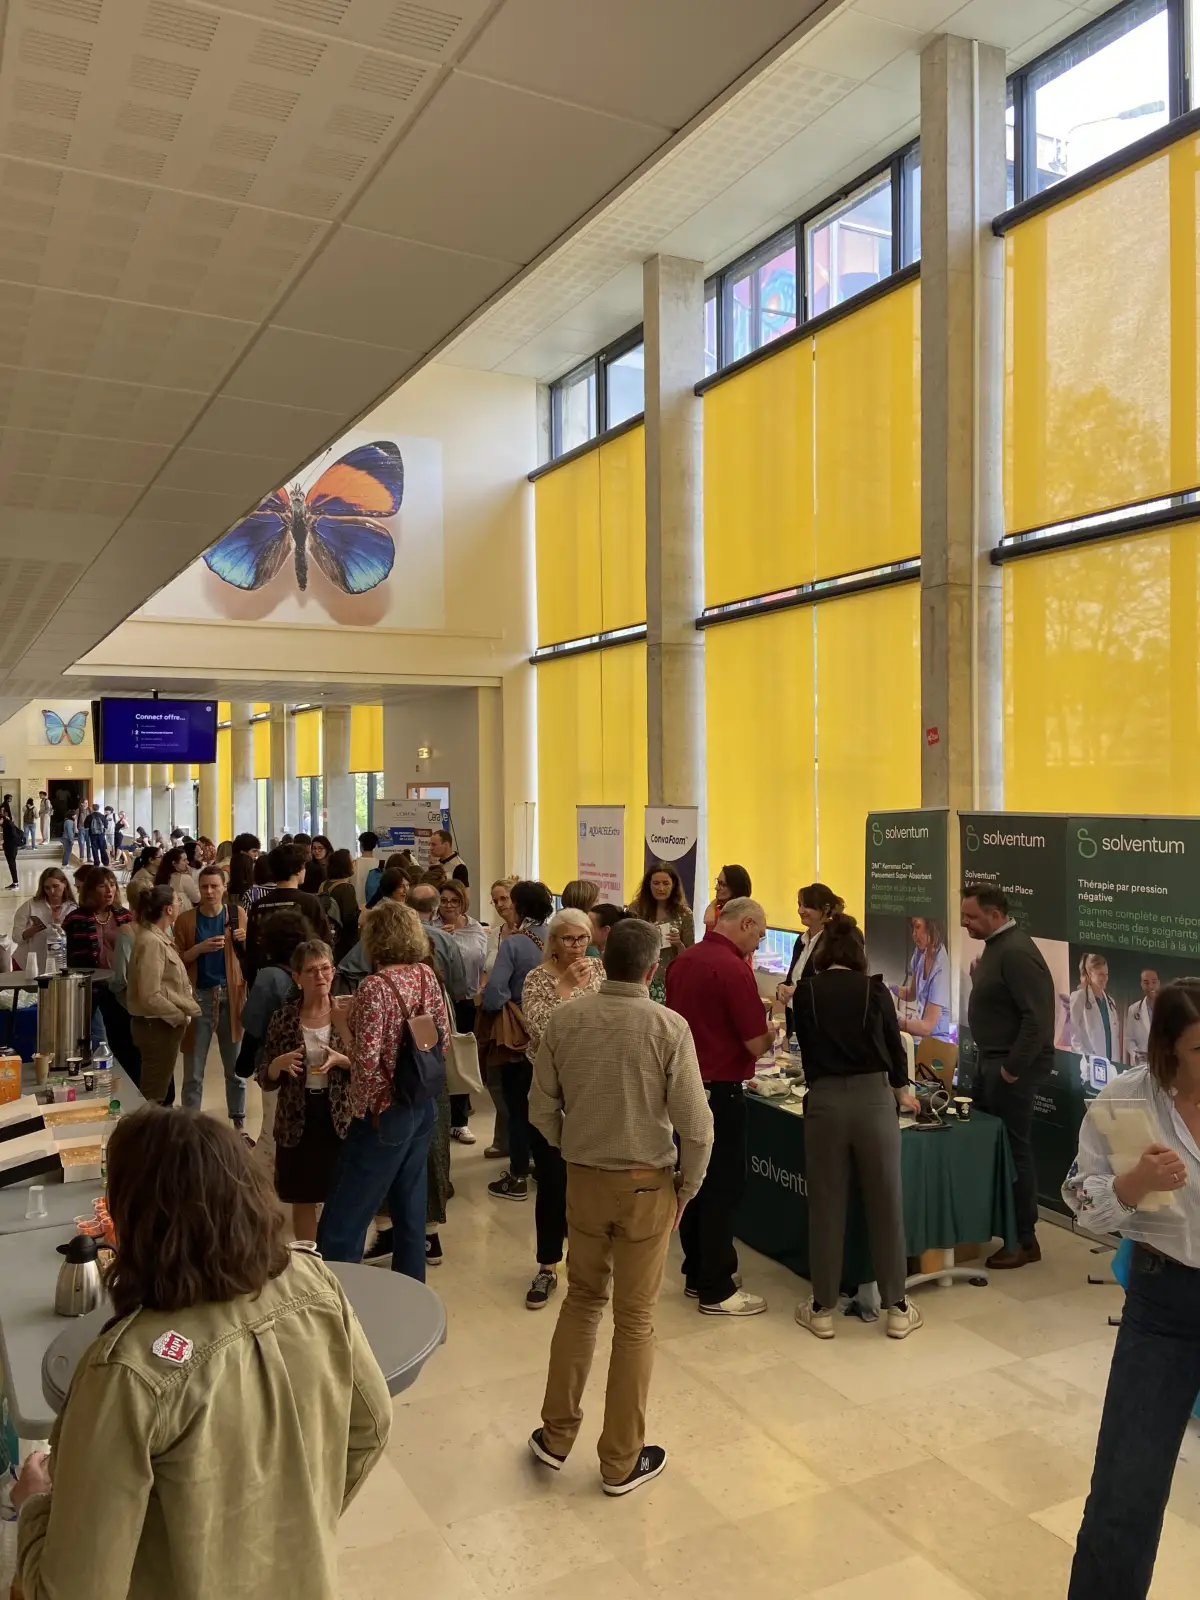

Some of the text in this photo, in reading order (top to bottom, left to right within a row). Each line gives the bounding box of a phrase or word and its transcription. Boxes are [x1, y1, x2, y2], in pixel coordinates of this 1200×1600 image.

[135, 713, 163, 721] Connect
[886, 826, 928, 838] solventum
[983, 830, 1045, 848] solventum
[1102, 834, 1185, 854] solventum
[1002, 885, 1013, 893] and
[1015, 886, 1033, 895] Place
[1078, 879, 1168, 894] Thérapie par pression
[1078, 892, 1113, 902] négative
[1078, 905, 1113, 916] Gamme
[1116, 910, 1158, 922] complète
[1160, 915, 1172, 923] en
[1079, 918, 1198, 939] aux besoins des soignants
[1118, 934, 1129, 944] de
[1178, 940, 1187, 951] la
